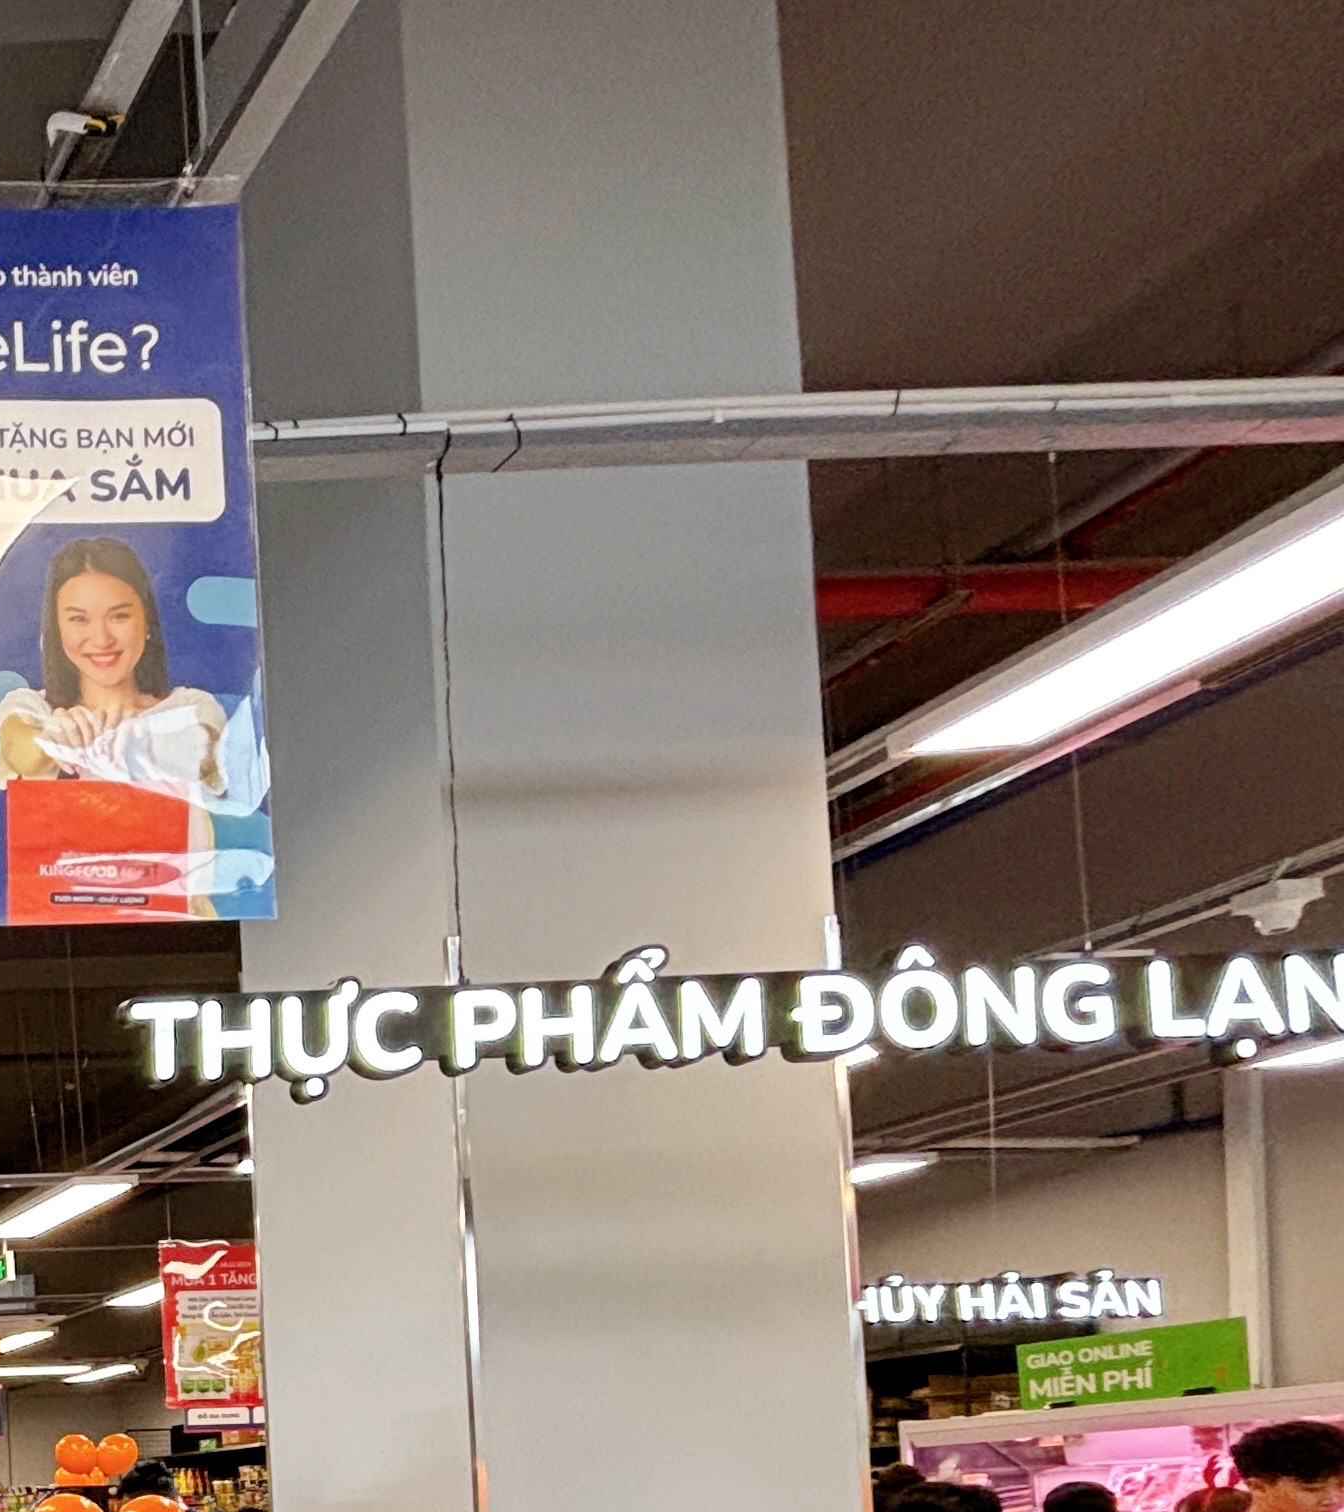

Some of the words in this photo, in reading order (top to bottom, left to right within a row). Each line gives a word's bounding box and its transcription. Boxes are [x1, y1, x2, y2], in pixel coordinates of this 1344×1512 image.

[11, 264, 83, 289] thành
[88, 264, 139, 288] viên
[76, 427, 135, 455] BẠN
[143, 420, 196, 448] MỚI
[90, 453, 192, 503] SẮM
[129, 978, 424, 1099] THỰC
[454, 946, 766, 1069] PHẨM
[790, 945, 1116, 1054] ĐÔNG
[1147, 953, 1344, 1060] LẠN
[857, 1273, 947, 1324] HỦY
[957, 1270, 1047, 1321] HẢI
[1058, 1269, 1163, 1318] SẢN
[1026, 1350, 1075, 1370] GIAO
[1077, 1340, 1154, 1362] ONLINE
[1029, 1367, 1097, 1400] MIỄN
[1102, 1359, 1153, 1393] PHÍ
